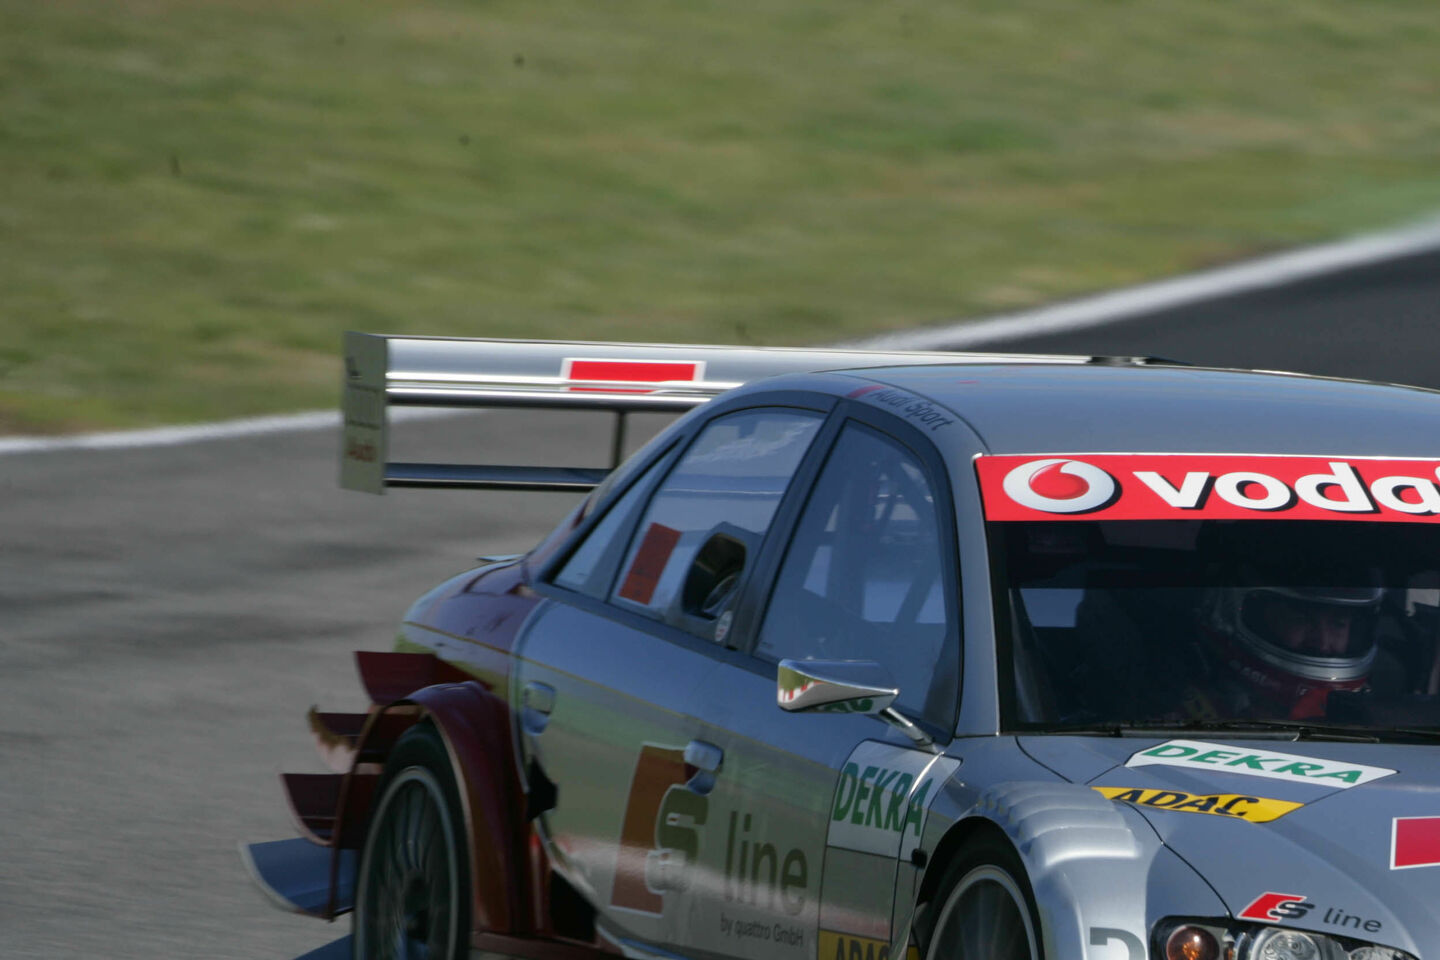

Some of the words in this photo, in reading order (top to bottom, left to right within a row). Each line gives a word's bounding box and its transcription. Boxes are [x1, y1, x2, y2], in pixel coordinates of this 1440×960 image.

[904, 402, 955, 431] Sport
[1142, 744, 1364, 784] DEKRA
[832, 761, 934, 837] DEKRA
[1110, 788, 1260, 817] ADAC
[724, 811, 808, 917] line
[720, 912, 734, 938] by
[735, 919, 771, 941] quattro
[773, 923, 804, 948] GmbH
[1322, 907, 1383, 934] line
